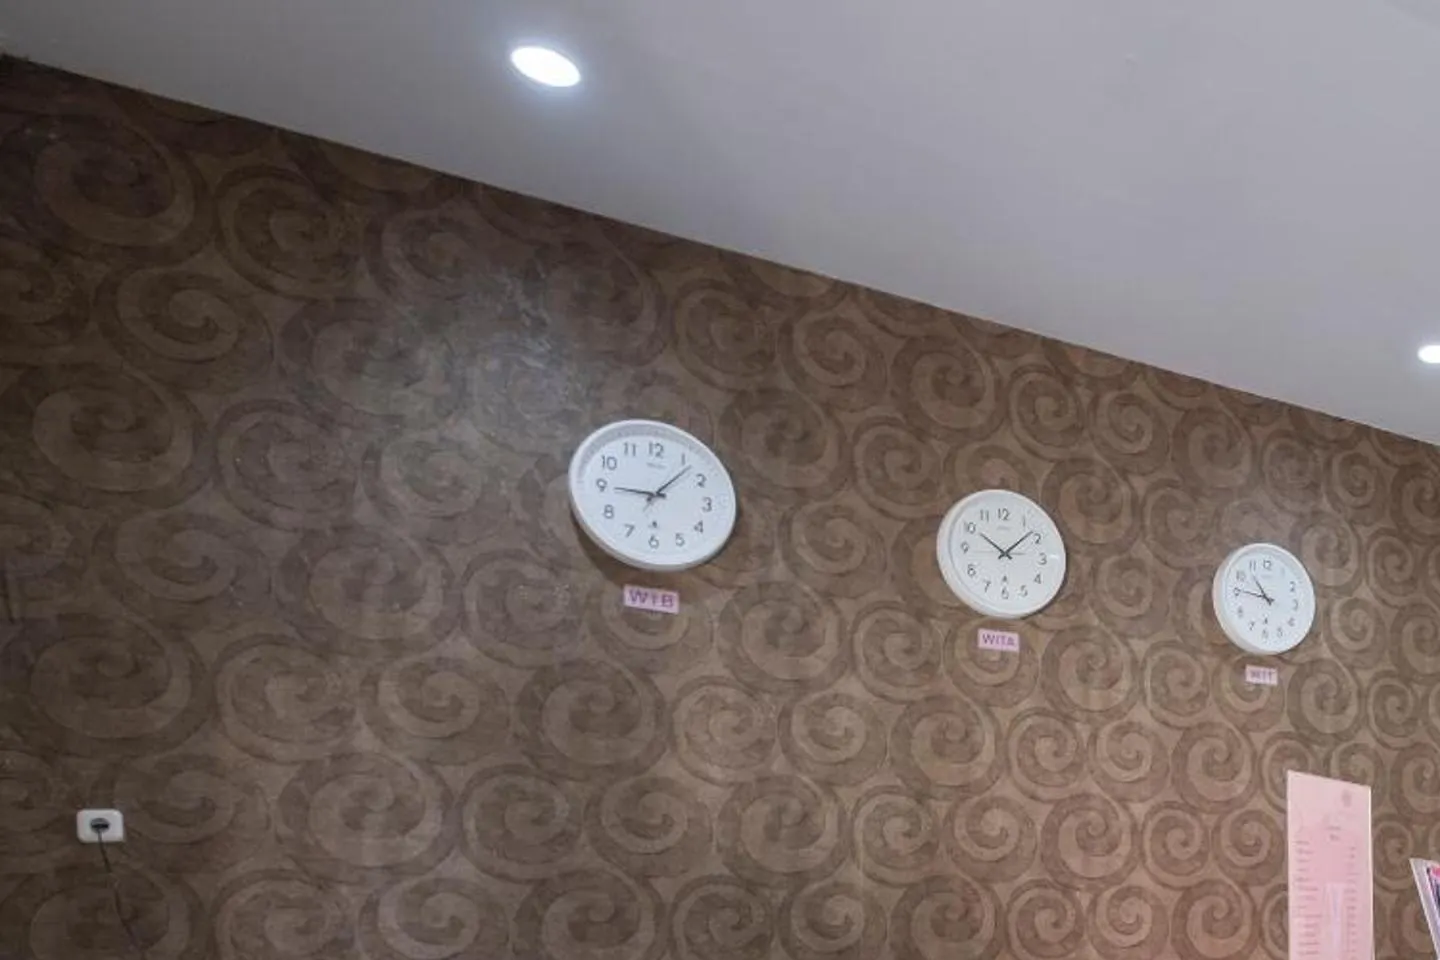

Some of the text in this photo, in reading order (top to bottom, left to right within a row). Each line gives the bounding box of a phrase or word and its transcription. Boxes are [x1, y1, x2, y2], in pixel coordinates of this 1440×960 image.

[623, 442, 637, 457] 11
[649, 443, 664, 459] 12
[601, 455, 617, 470] 10
[681, 453, 686, 465] 1
[596, 478, 608, 492] 9
[696, 473, 707, 488] 2
[702, 497, 712, 512] 3
[603, 504, 615, 519] 8
[980, 509, 990, 522] 11
[997, 508, 1010, 521] 12
[624, 524, 635, 537] 7
[694, 520, 704, 533] 4
[964, 521, 976, 534] 10
[649, 536, 660, 549] 6
[675, 533, 685, 546] 5
[1033, 533, 1042, 544] 2
[961, 542, 970, 553] 9
[1038, 553, 1047, 565] 3
[1034, 573, 1042, 584] 4
[983, 579, 991, 592] 7
[1020, 585, 1028, 598] 5
[629, 588, 674, 607] WIB
[1001, 587, 1009, 600] 6
[982, 634, 1017, 647] WITA
